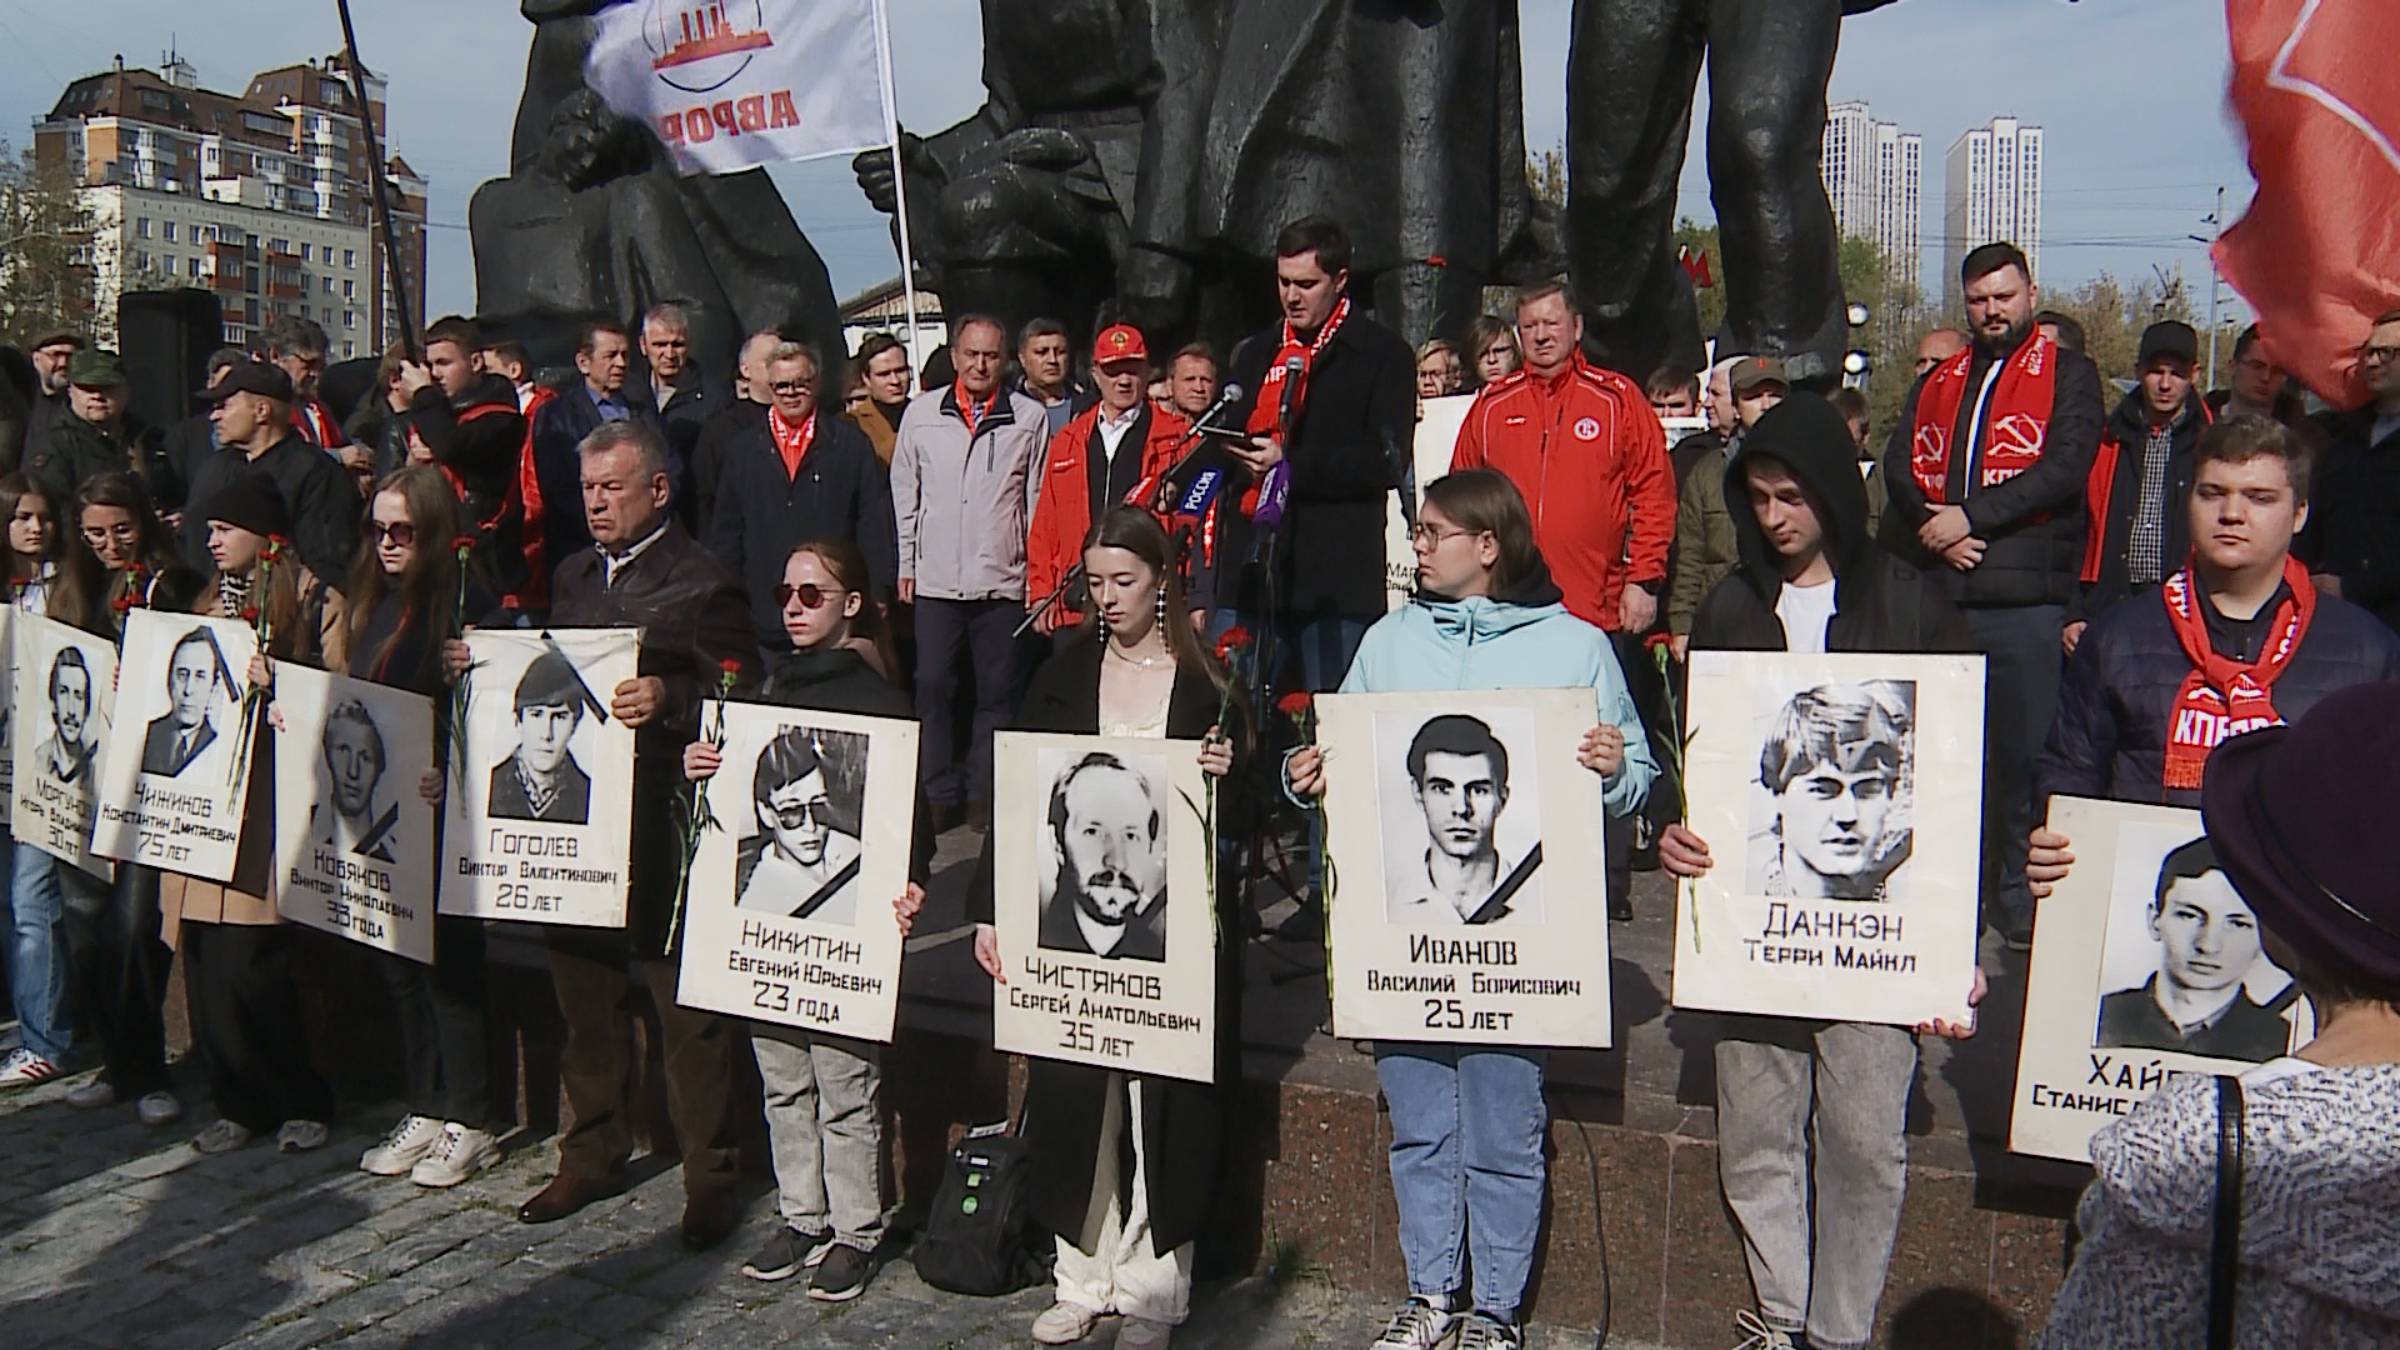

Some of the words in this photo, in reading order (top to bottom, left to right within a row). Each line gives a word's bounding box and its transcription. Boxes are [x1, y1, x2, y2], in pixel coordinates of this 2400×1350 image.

[1184, 471, 1217, 510] РОССИЯ
[102, 803, 170, 830] КОНСТАНТИН
[135, 782, 212, 818] ЧИЖИКОВ
[48, 824, 64, 850] 30
[139, 831, 166, 857] 75
[166, 844, 191, 862] ЛЕТ
[490, 828, 578, 858] ГОГОЛЕВ
[314, 849, 391, 893] КОБЯКОВ
[459, 857, 508, 878] ВИКТОР
[520, 861, 617, 885] ВАЛЕНТИНОВИЧ
[290, 867, 335, 894] ВИКТОР
[340, 884, 414, 921] НИКОЛАЕВИЧ
[496, 884, 530, 910] 26
[532, 896, 563, 912] ЛЕТ
[327, 900, 351, 928] 33
[1763, 902, 1904, 942] ДАНКЭН
[741, 919, 862, 965] НИКИТИН
[1410, 933, 1518, 966] ИВАНОВ
[1743, 938, 1823, 967] ТЕРРИ
[1834, 944, 1917, 973] МАЙКЛ
[729, 950, 800, 981] ЕВГЕНИЙ
[803, 964, 882, 996] ЮРЬЕВИЧ
[1025, 956, 1161, 1000] ЧИСТЯКОВ
[1367, 969, 1456, 993] ВАСИЛИЙ
[1472, 972, 1581, 996] БОРИСОВИЧ
[753, 980, 790, 1012] 23
[796, 998, 840, 1024] ГОДА
[1010, 987, 1070, 1016] СЕРГЕЙ
[1078, 997, 1201, 1033] АНАТОЛЬЕВИЧ
[1424, 999, 1465, 1029] 25
[1469, 1012, 1513, 1031] ЛЕТ
[1059, 1020, 1094, 1052] 35
[1099, 1036, 1135, 1059] ЛЕТ
[2087, 1054, 2183, 1091] ХАЙ
